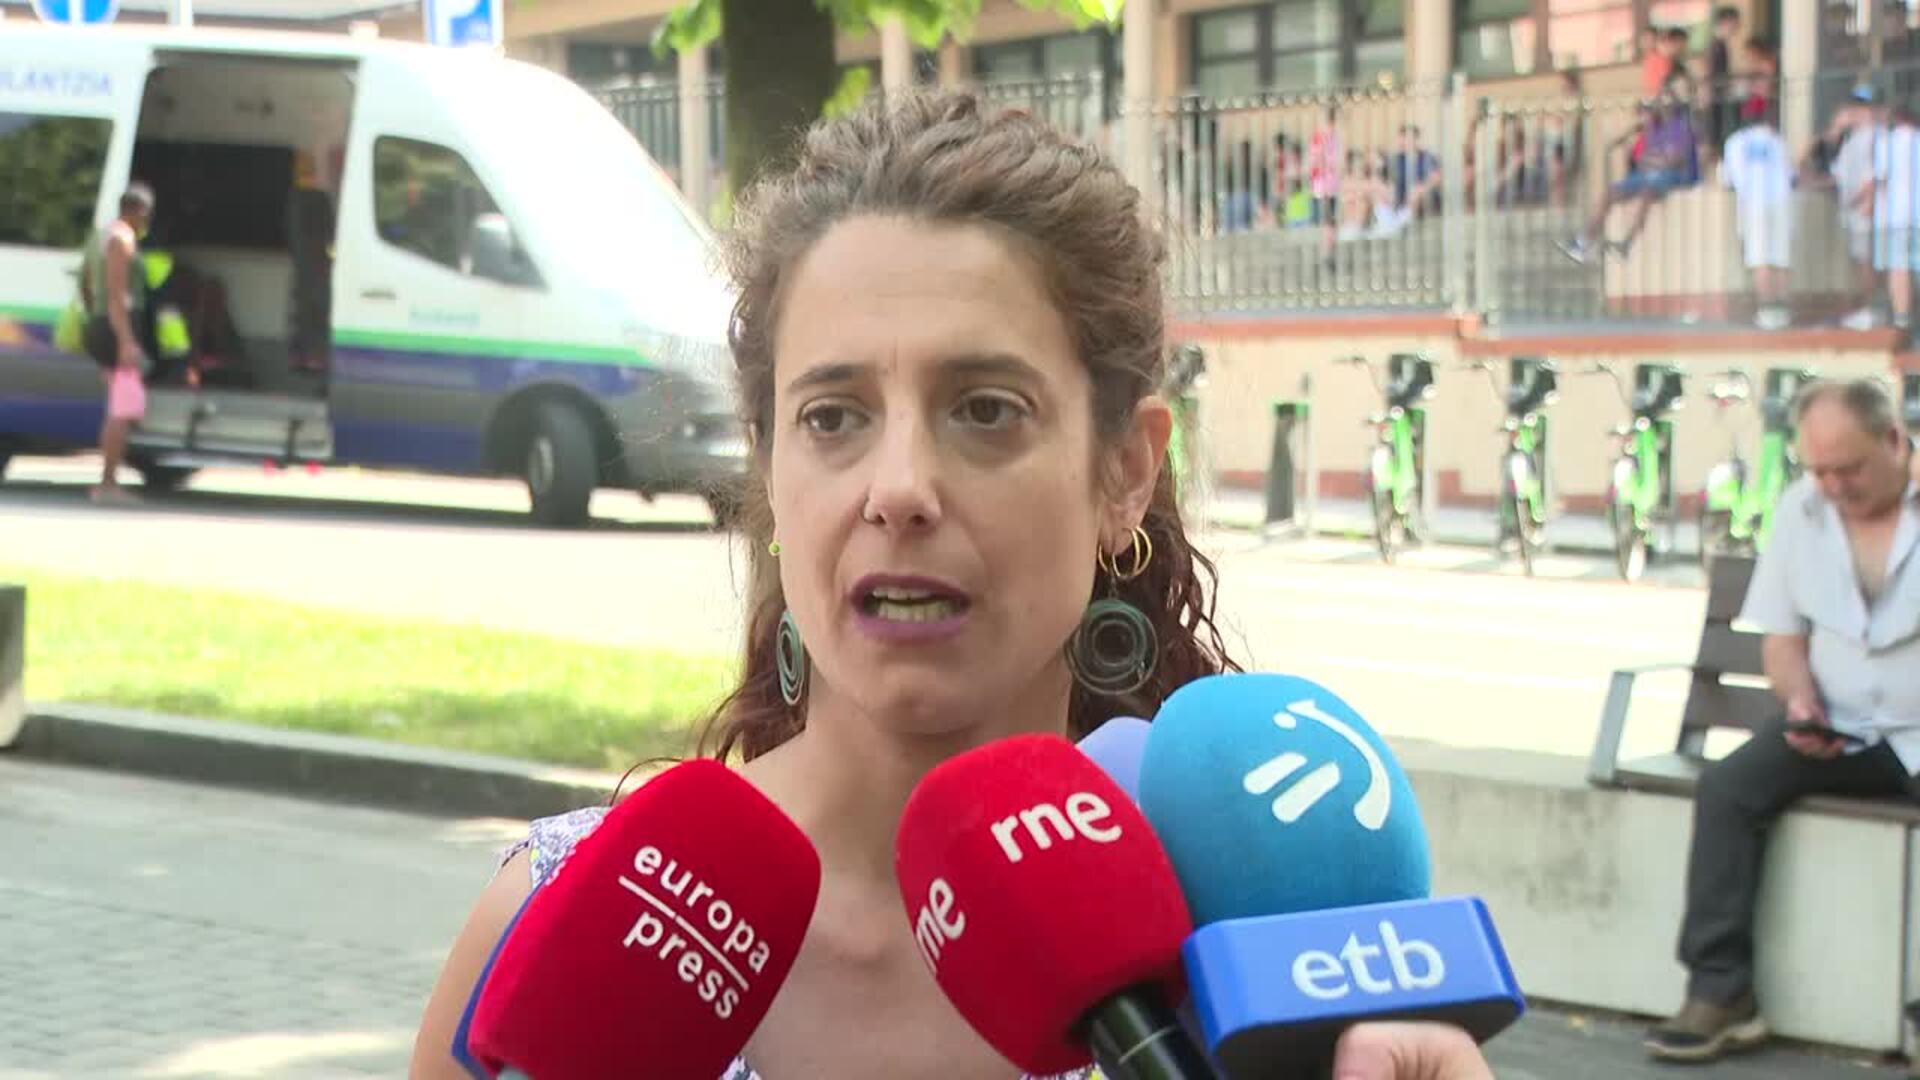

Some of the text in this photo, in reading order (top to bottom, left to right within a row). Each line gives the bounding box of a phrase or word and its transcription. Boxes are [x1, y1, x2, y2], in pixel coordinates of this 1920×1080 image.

[990, 791, 1123, 864] rne
[633, 845, 771, 974] europa
[622, 911, 740, 1019] press
[1291, 920, 1446, 1000] etb
